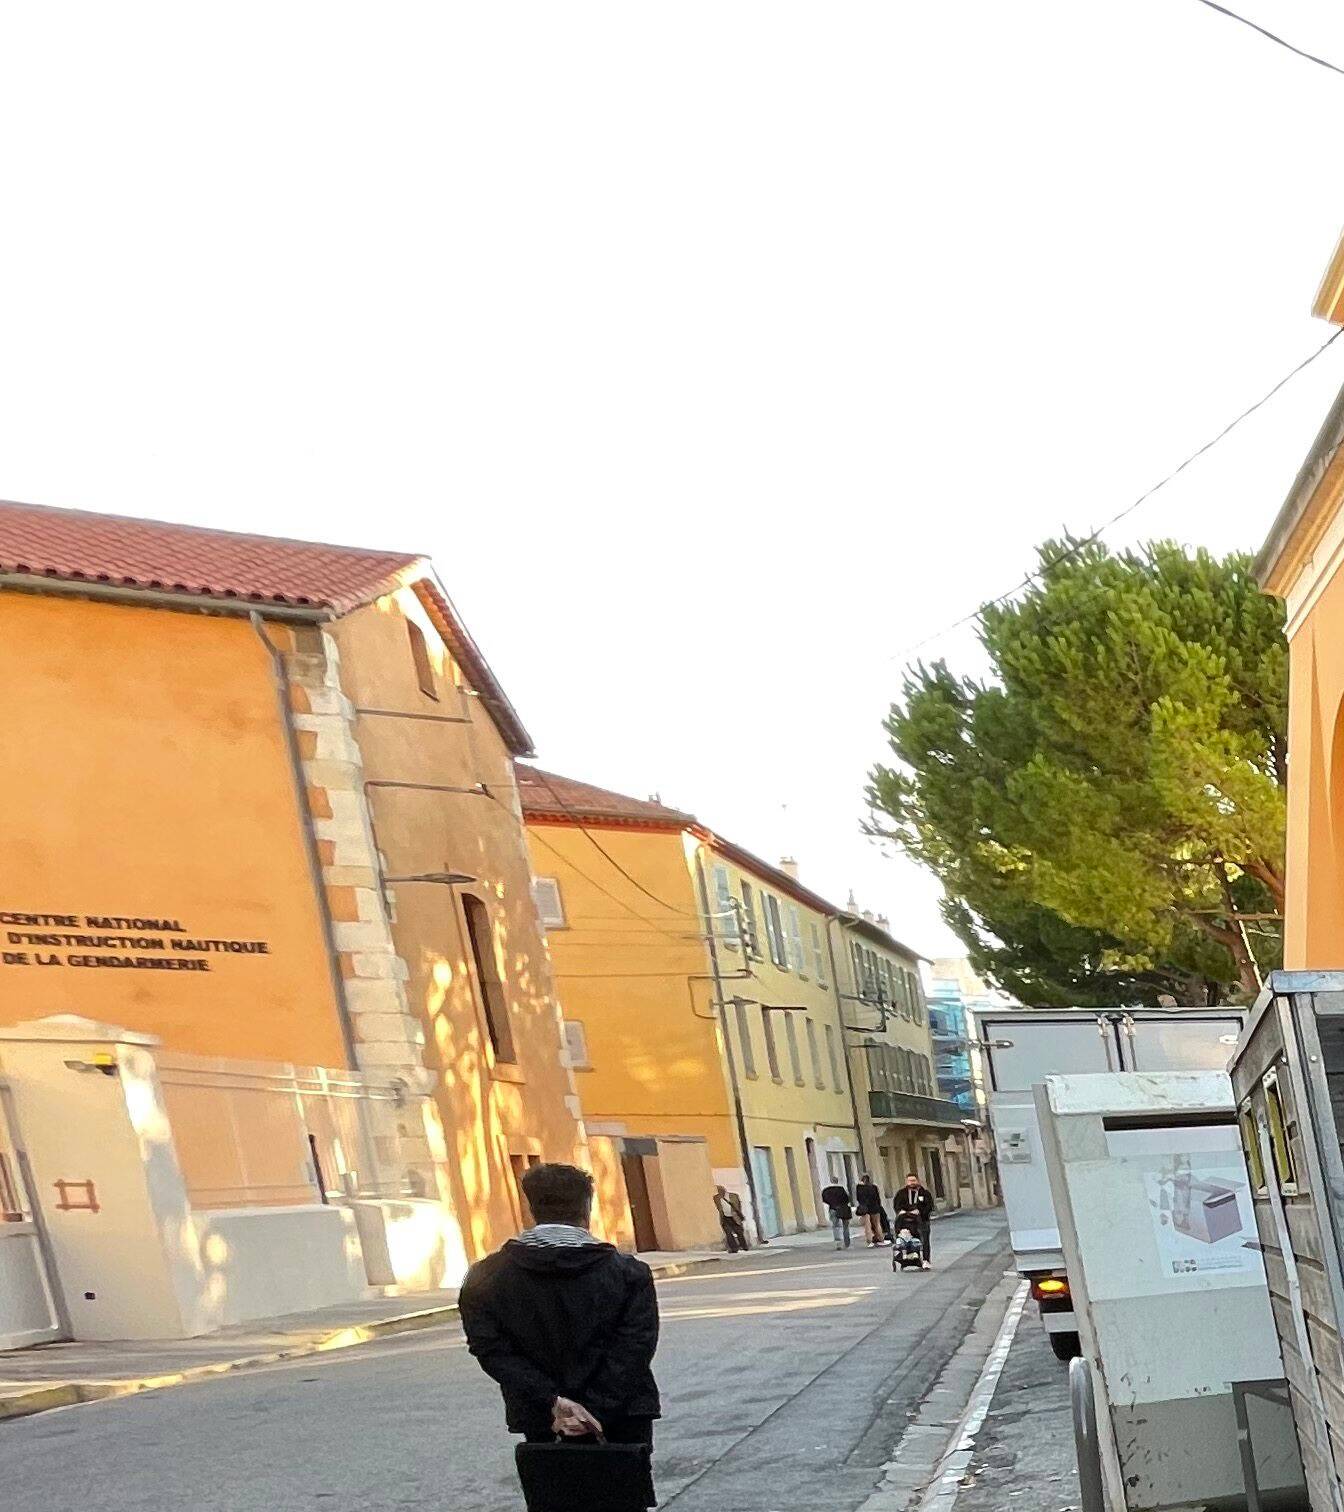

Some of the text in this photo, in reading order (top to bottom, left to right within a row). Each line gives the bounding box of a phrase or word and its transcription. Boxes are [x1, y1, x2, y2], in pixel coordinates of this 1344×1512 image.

[0, 912, 186, 932] CENTRE NATIONAL
[7, 932, 269, 954] D'INSTRUCTION NAUTIQUE
[3, 952, 210, 972] DE LA GENDARMERIE
